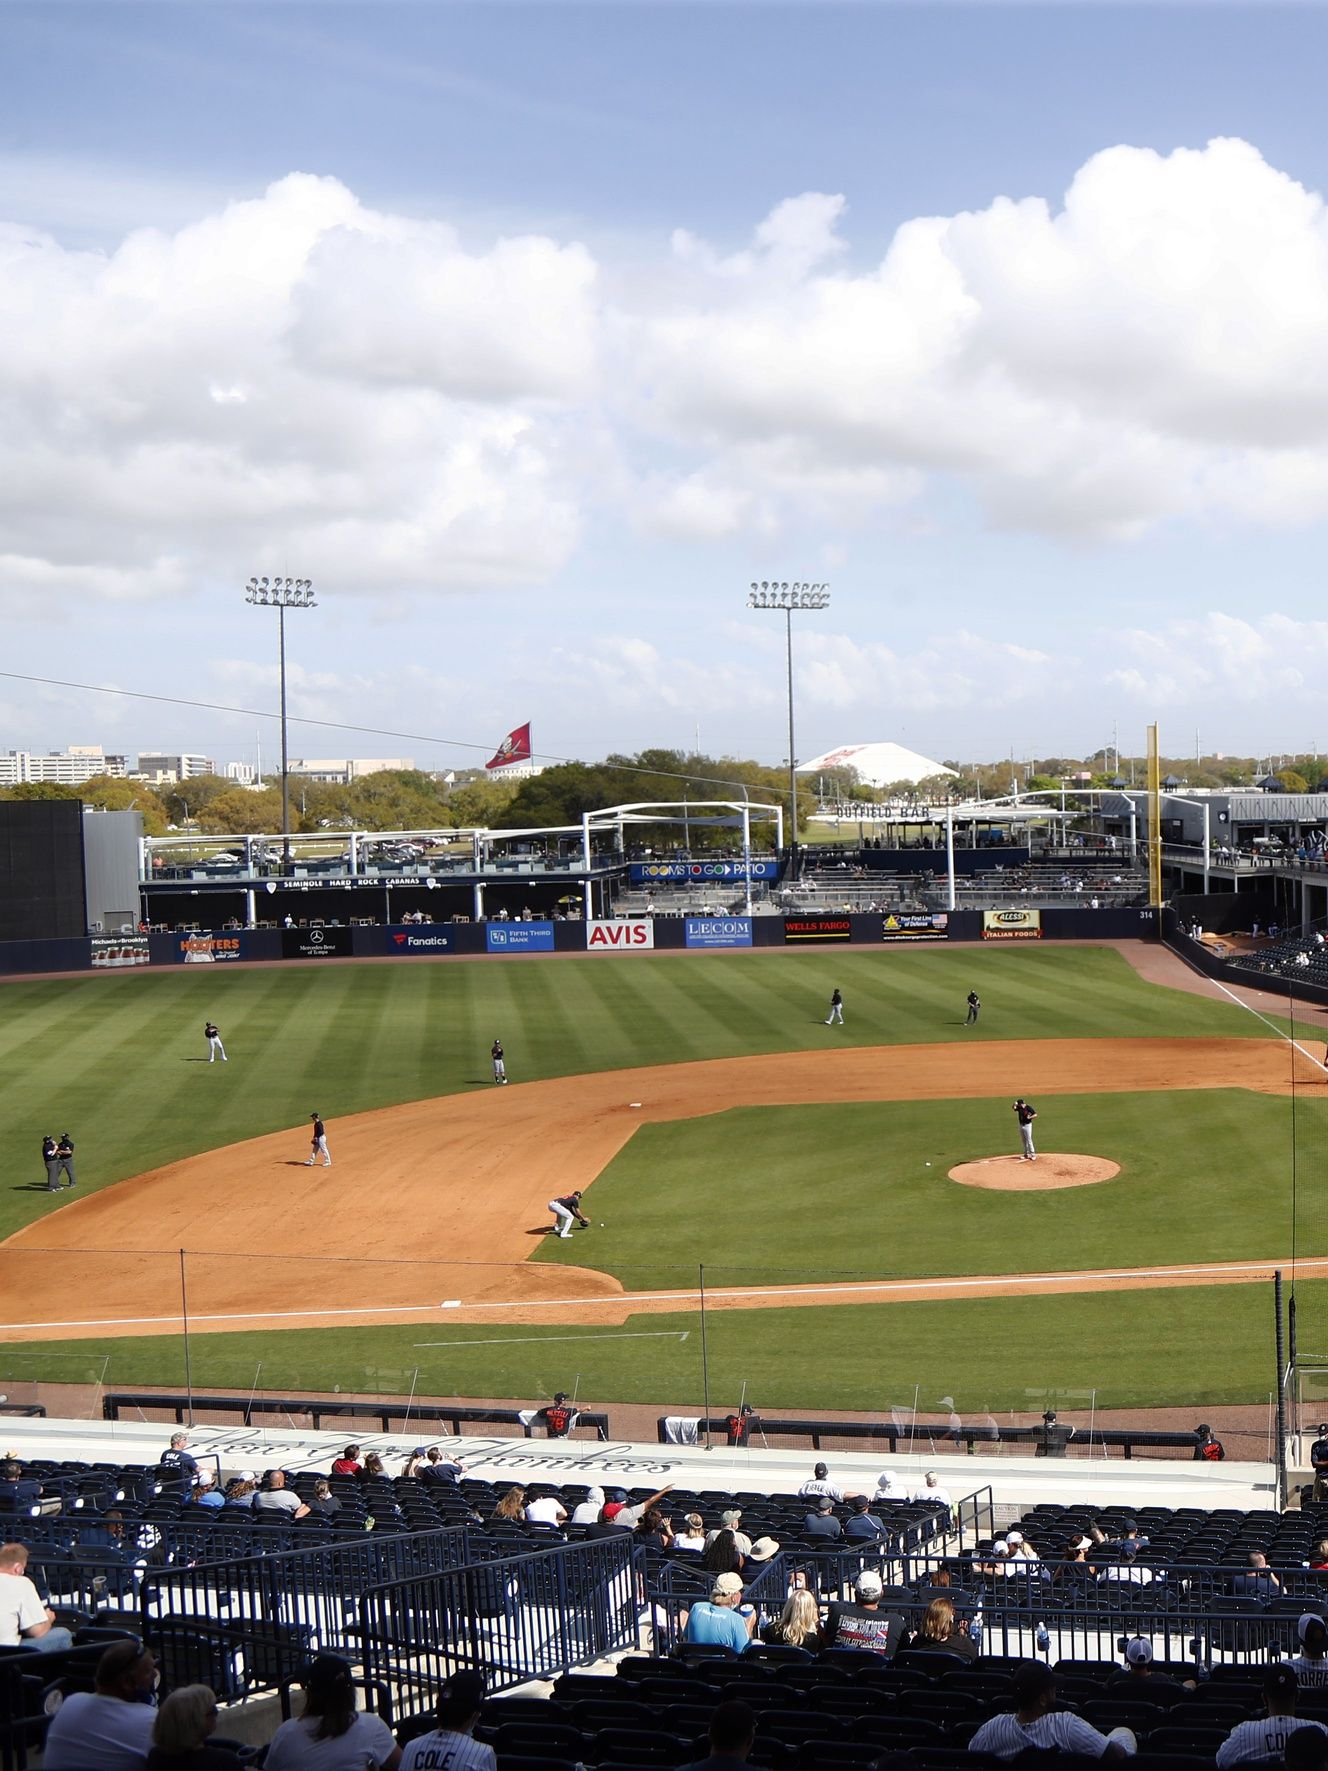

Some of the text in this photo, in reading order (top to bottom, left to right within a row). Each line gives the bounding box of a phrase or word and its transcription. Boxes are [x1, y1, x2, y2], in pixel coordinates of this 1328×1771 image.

[641, 865, 685, 876] ROOMS
[687, 864, 702, 875] TO
[704, 863, 724, 875] GO
[284, 877, 420, 888] SEMINOLE HARD ROCK CABANAS
[999, 912, 1025, 921] ALESSI
[1139, 911, 1153, 919] 314
[786, 921, 850, 931] WELLS FARGO
[407, 936, 448, 946] Fanatics
[589, 924, 647, 945] AVIS
[180, 939, 240, 952] HOOTERS
[186, 1427, 305, 1455] New
[456, 1439, 683, 1474] Yankees
[1265, 1732, 1289, 1752] COL
[414, 1750, 456, 1771] COLE
